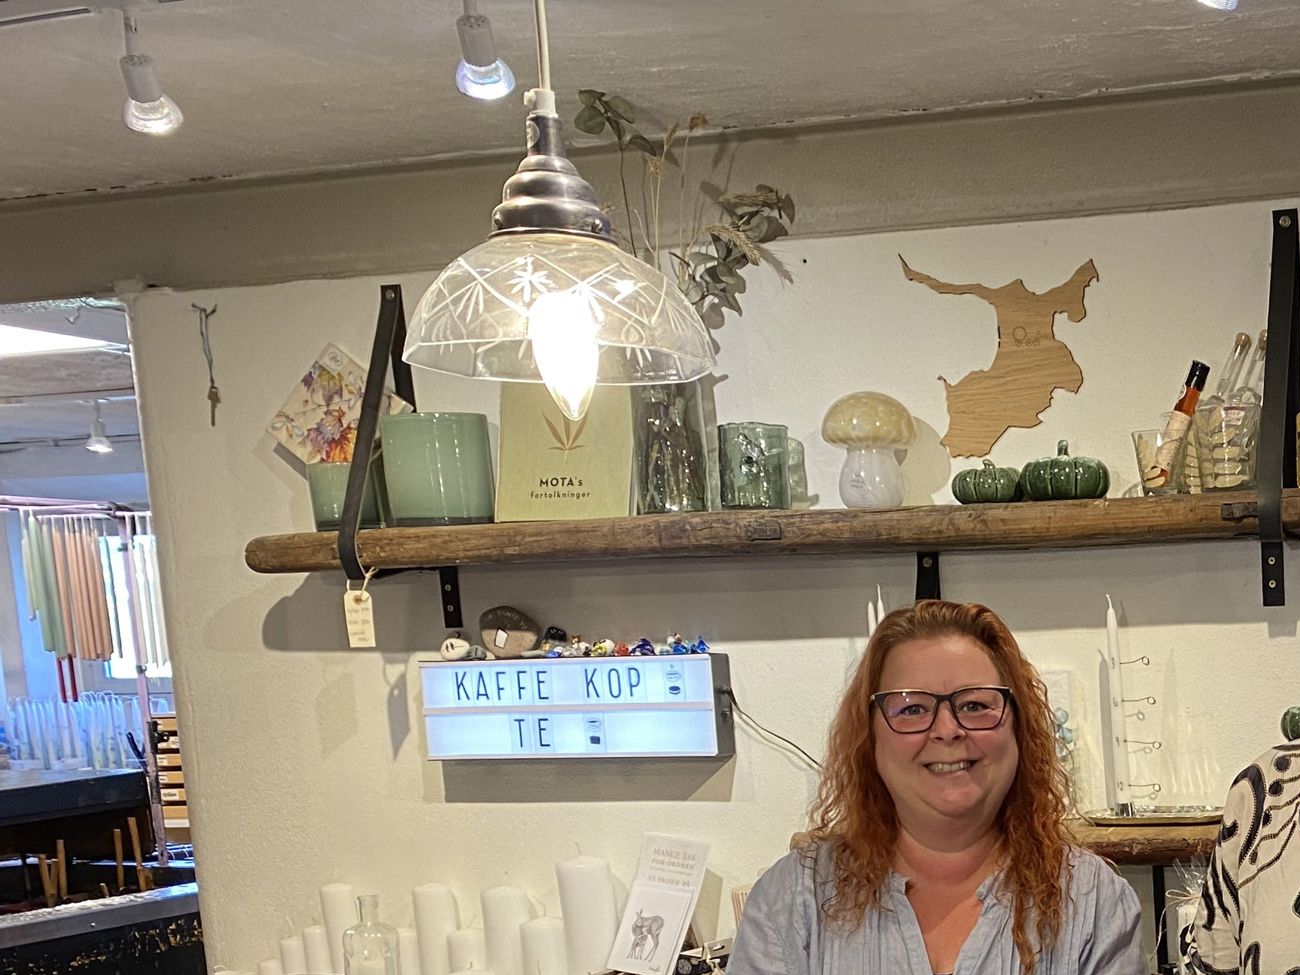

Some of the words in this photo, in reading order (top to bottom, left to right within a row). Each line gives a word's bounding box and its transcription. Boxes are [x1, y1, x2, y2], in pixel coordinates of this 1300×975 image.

[539, 477, 583, 487] MOTA's
[530, 491, 590, 500] fortolkninger
[455, 670, 549, 701] KAFFE
[584, 667, 641, 698] KOP
[514, 718, 551, 747] TE
